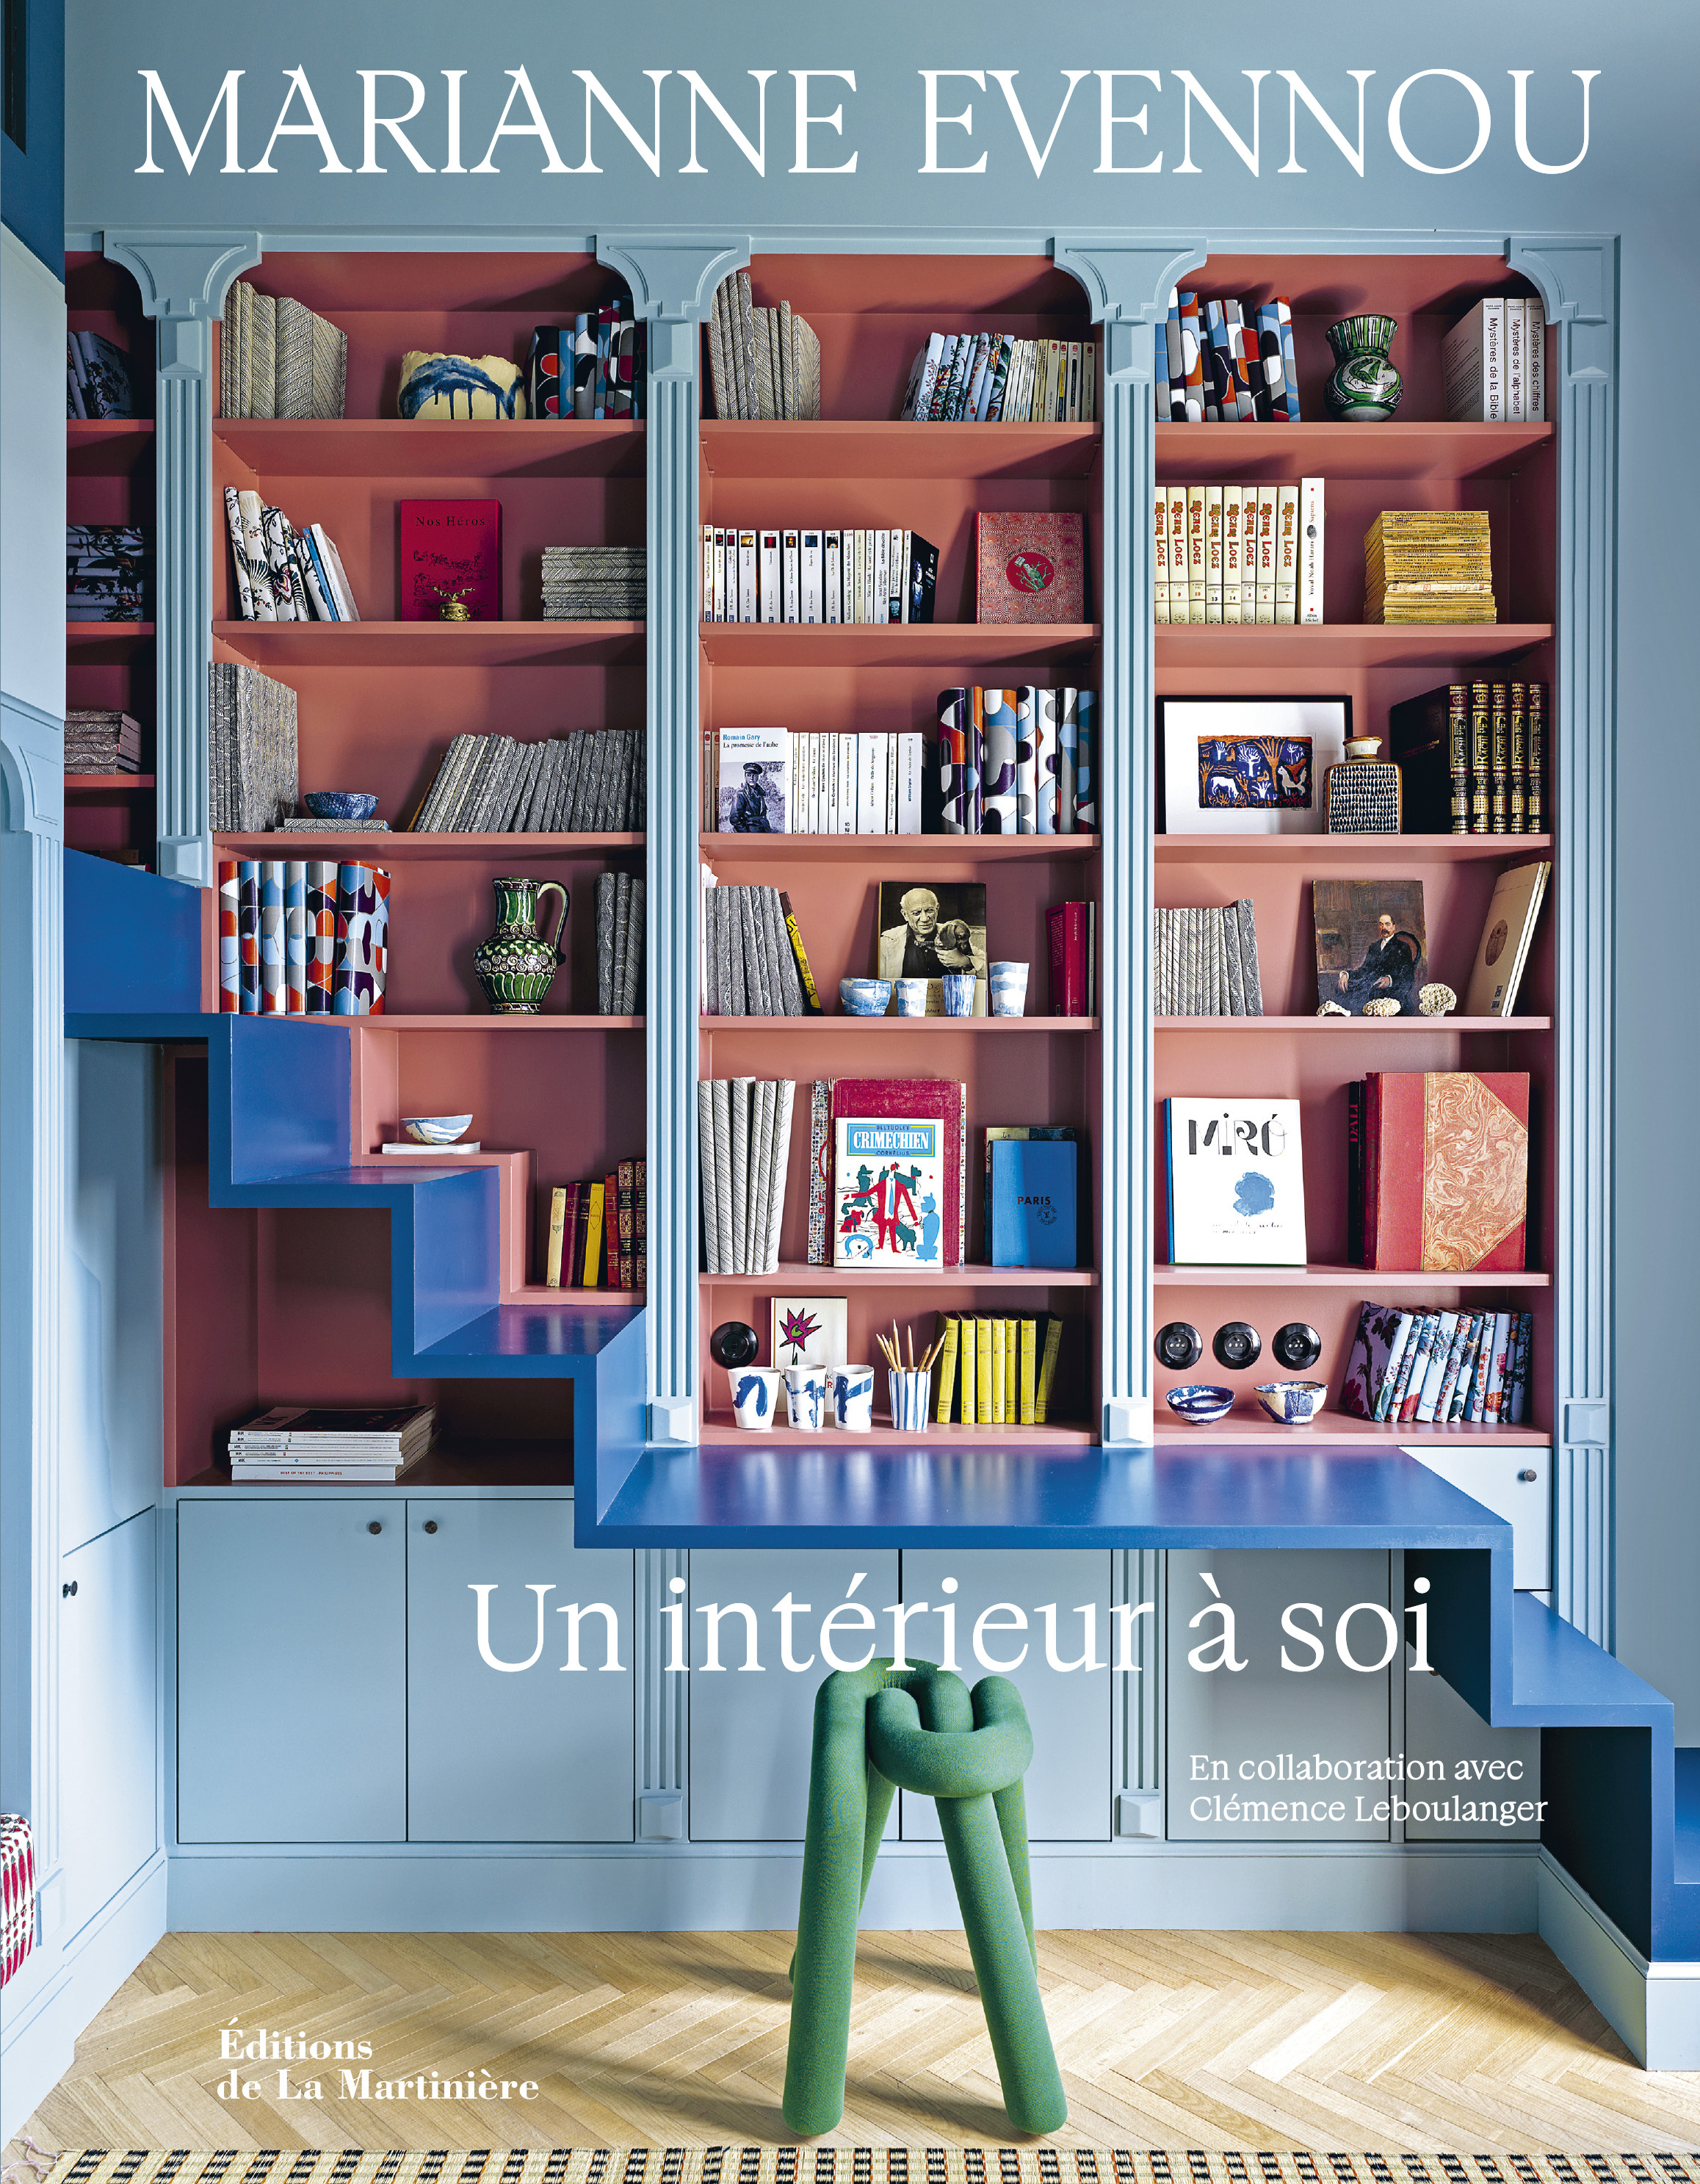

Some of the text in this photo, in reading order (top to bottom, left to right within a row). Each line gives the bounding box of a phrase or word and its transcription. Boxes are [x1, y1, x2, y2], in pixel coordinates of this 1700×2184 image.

[1488, 318, 1499, 419] Mystères de la Bible
[1511, 319, 1521, 414] Mystères de l'alphabet
[1530, 322, 1541, 412] Mystères des chiffres
[415, 516, 485, 526] Nos Héros
[1477, 736, 1489, 764] RACHI
[853, 1131, 929, 1149] CRIMECHIEN
[1017, 1196, 1051, 1205] PARIS
